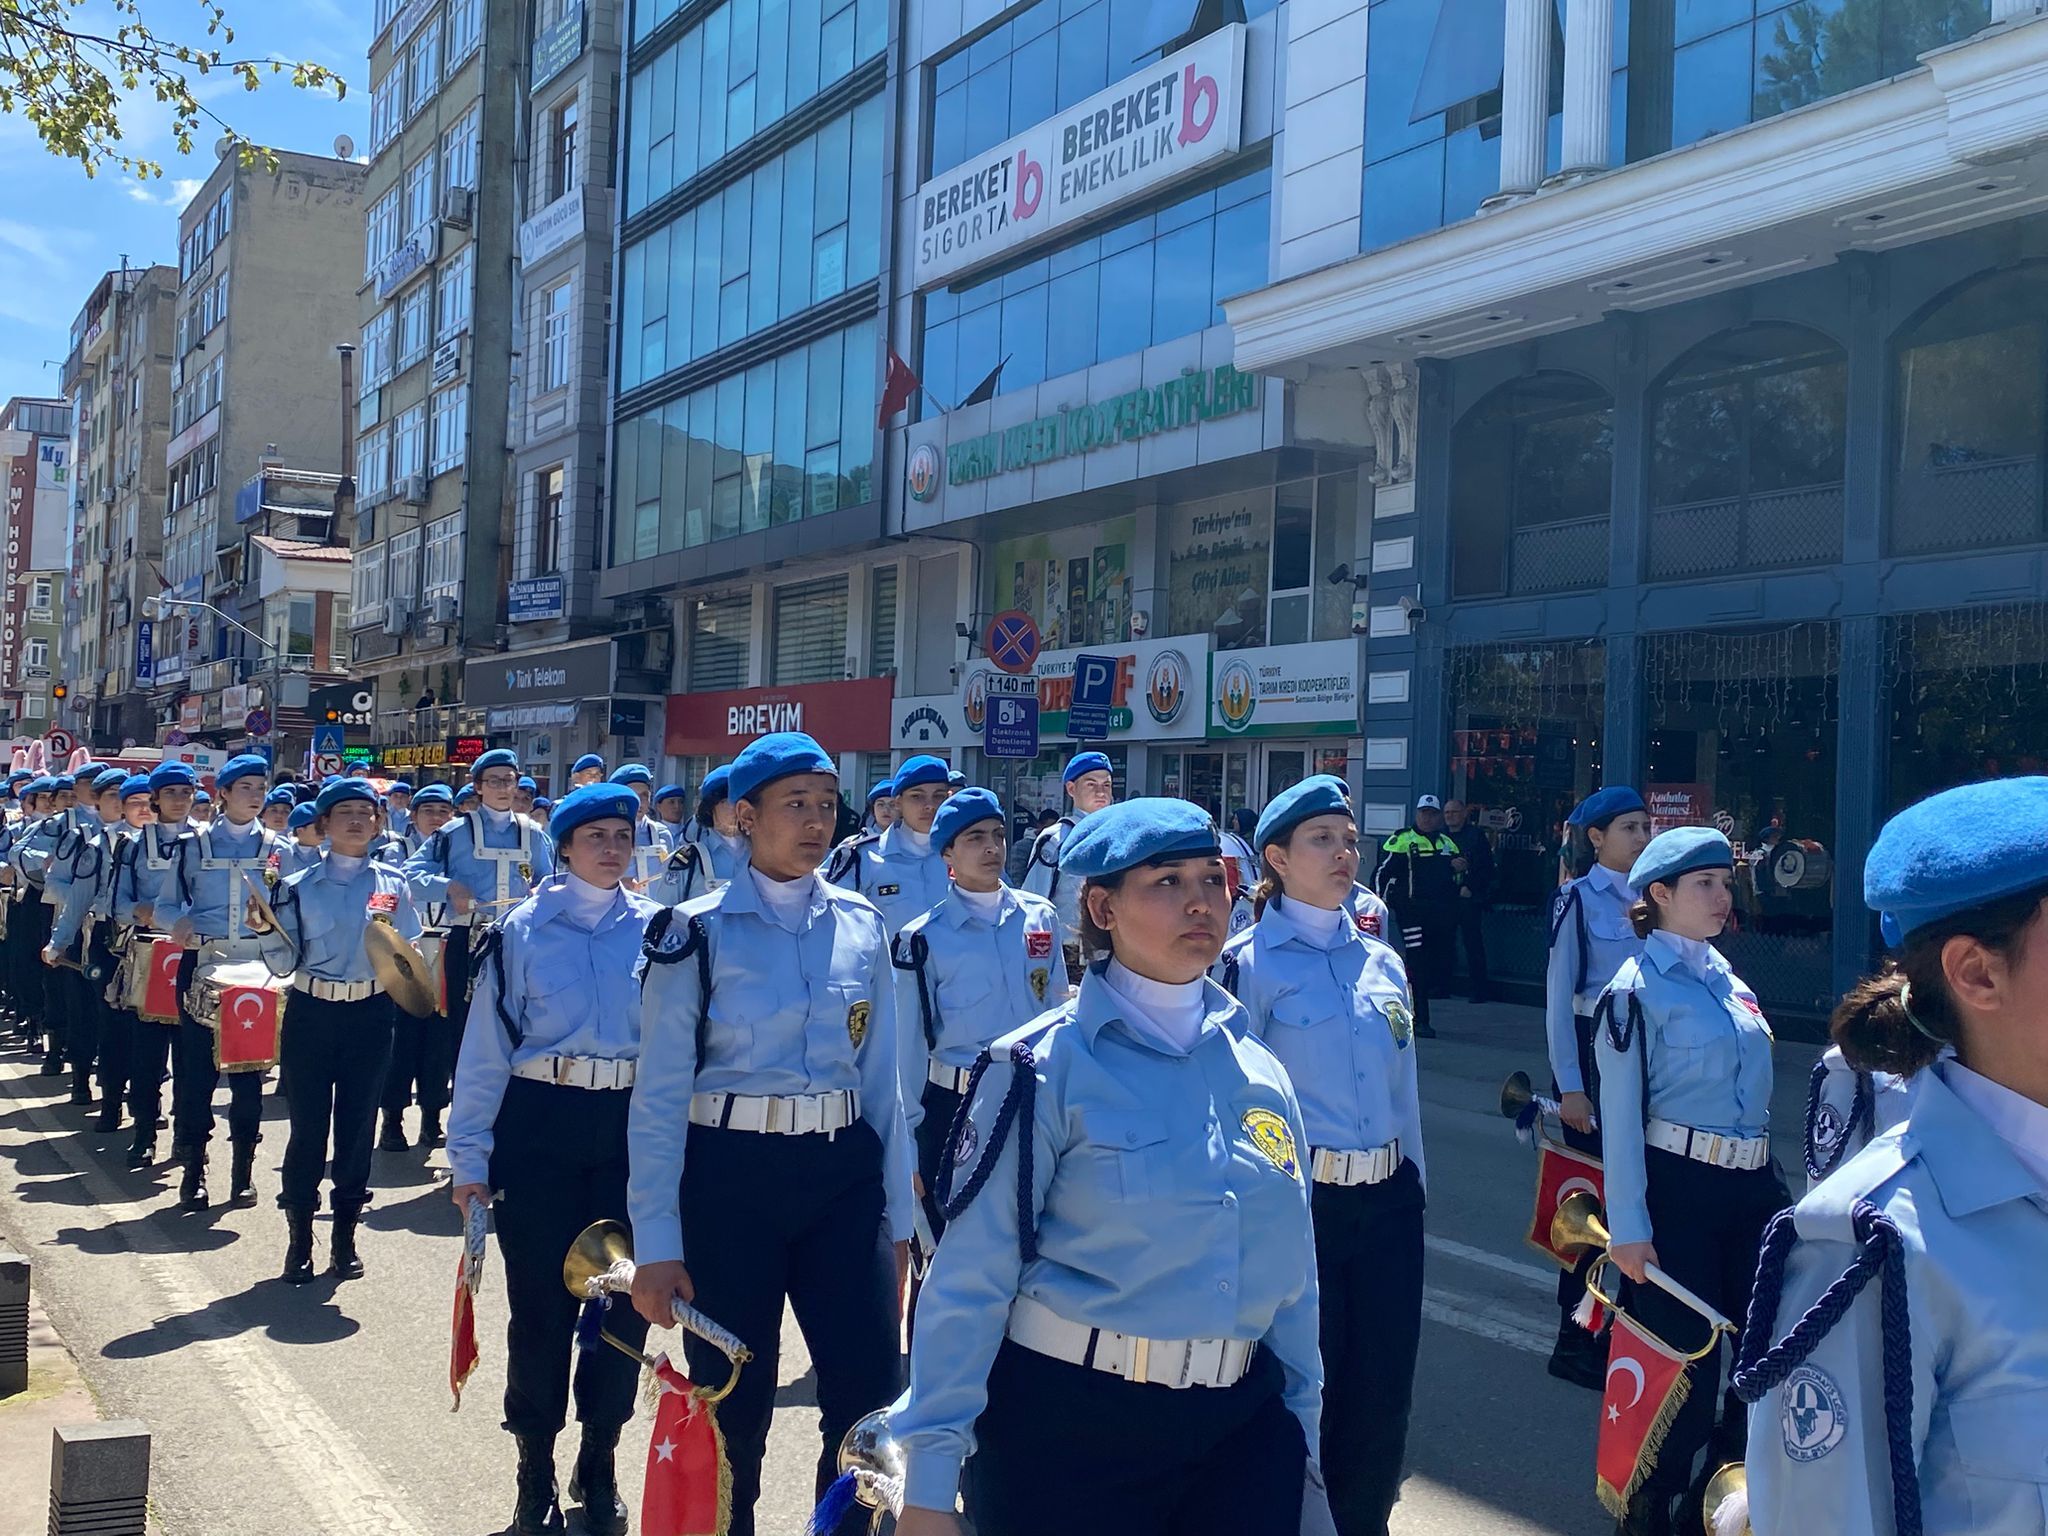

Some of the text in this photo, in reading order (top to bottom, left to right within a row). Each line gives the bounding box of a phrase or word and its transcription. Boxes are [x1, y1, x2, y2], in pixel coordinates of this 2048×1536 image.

[1062, 71, 1179, 166] BEREKET
[1059, 121, 1175, 205] EMEKLİLİK
[923, 156, 1013, 232] BEREKET
[41, 445, 64, 467] My
[1192, 506, 1253, 536] Türkiye'nin
[2, 486, 23, 690] MY HOUSE HOTEL
[516, 667, 566, 688] Türk Telekom
[1038, 662, 1067, 675] TÜRKİYE
[1259, 666, 1282, 678] TÜRKİYE
[996, 677, 1036, 693] 140 mt
[1083, 664, 1107, 699] P
[1259, 673, 1351, 695] TARIM KREDİ KOOPERATİFLERİ
[992, 728, 1031, 737] Elektronik
[997, 746, 1026, 755] Sistemi
